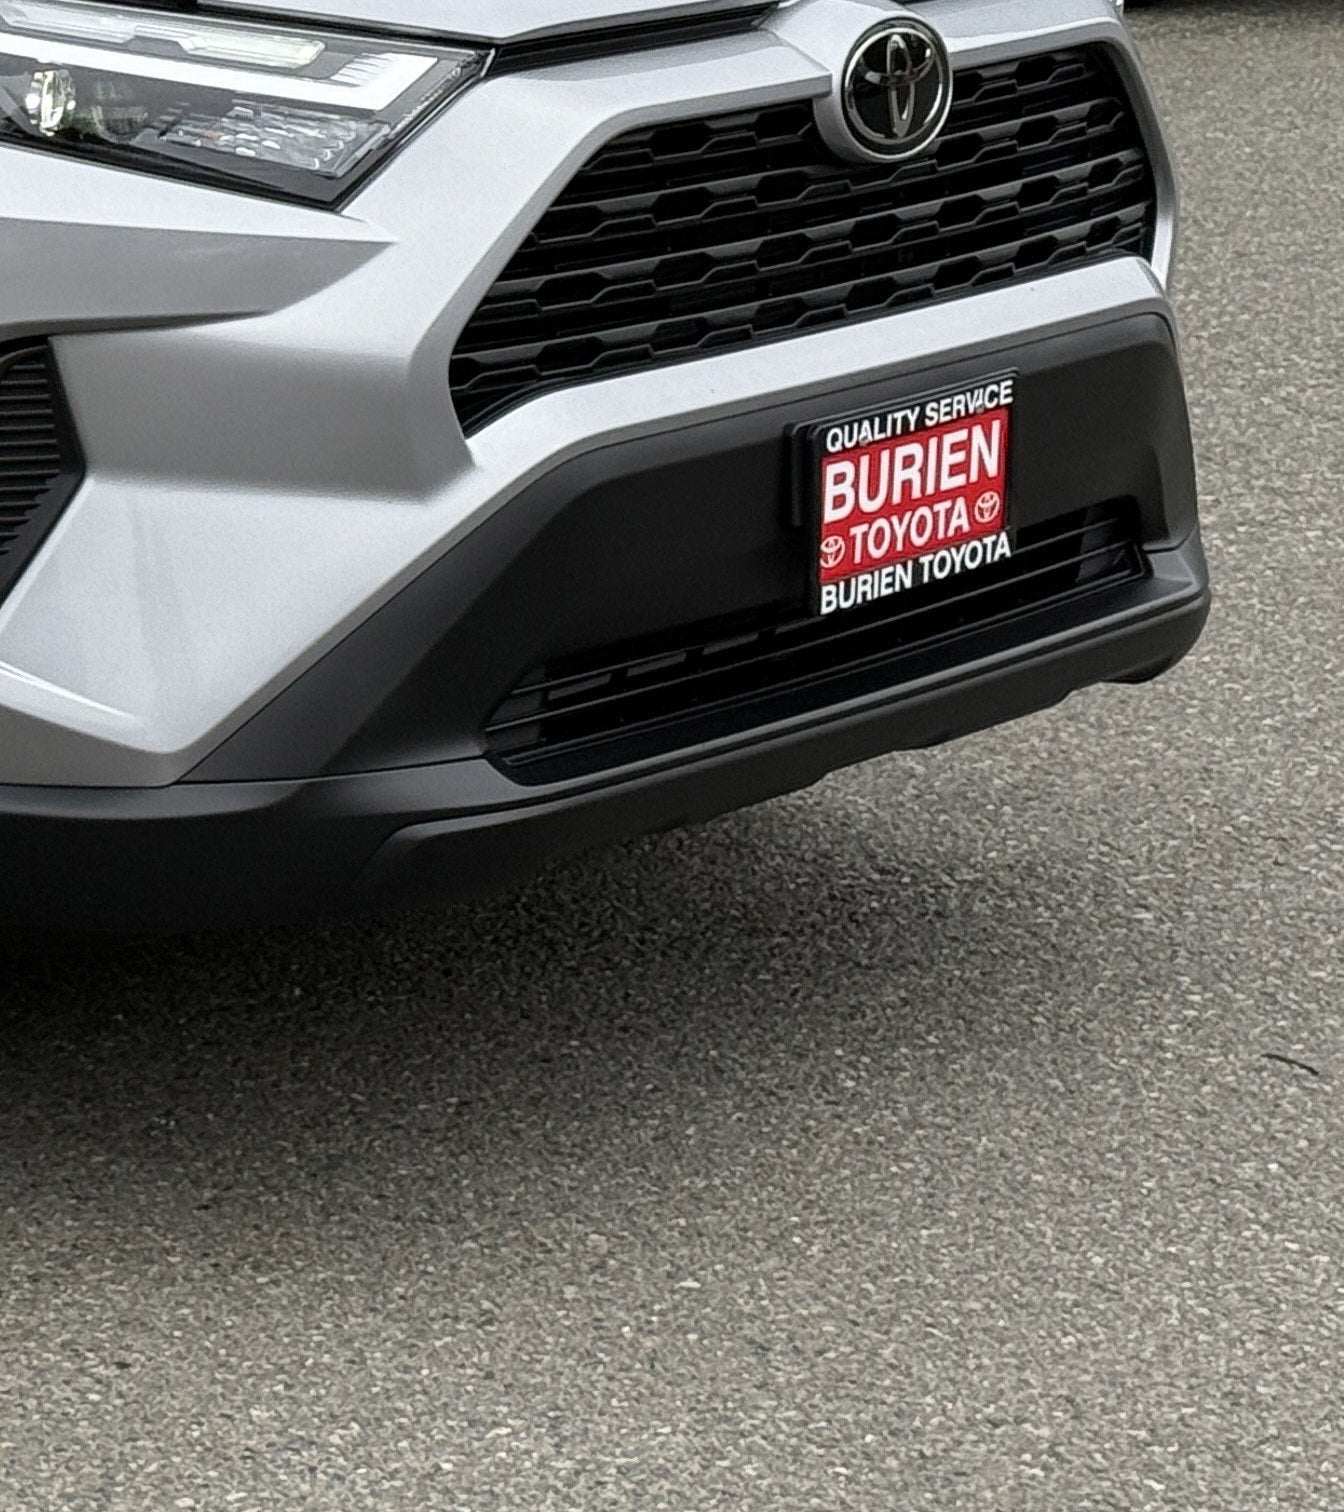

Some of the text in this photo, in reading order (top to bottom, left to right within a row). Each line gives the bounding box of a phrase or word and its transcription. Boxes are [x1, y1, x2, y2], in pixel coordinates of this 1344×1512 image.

[826, 380, 1014, 453] QUALITY SERVICE
[823, 419, 1001, 525] BURIEN
[849, 496, 971, 565] TOYOTA
[820, 531, 1012, 615] BURIEN TOYOTA
